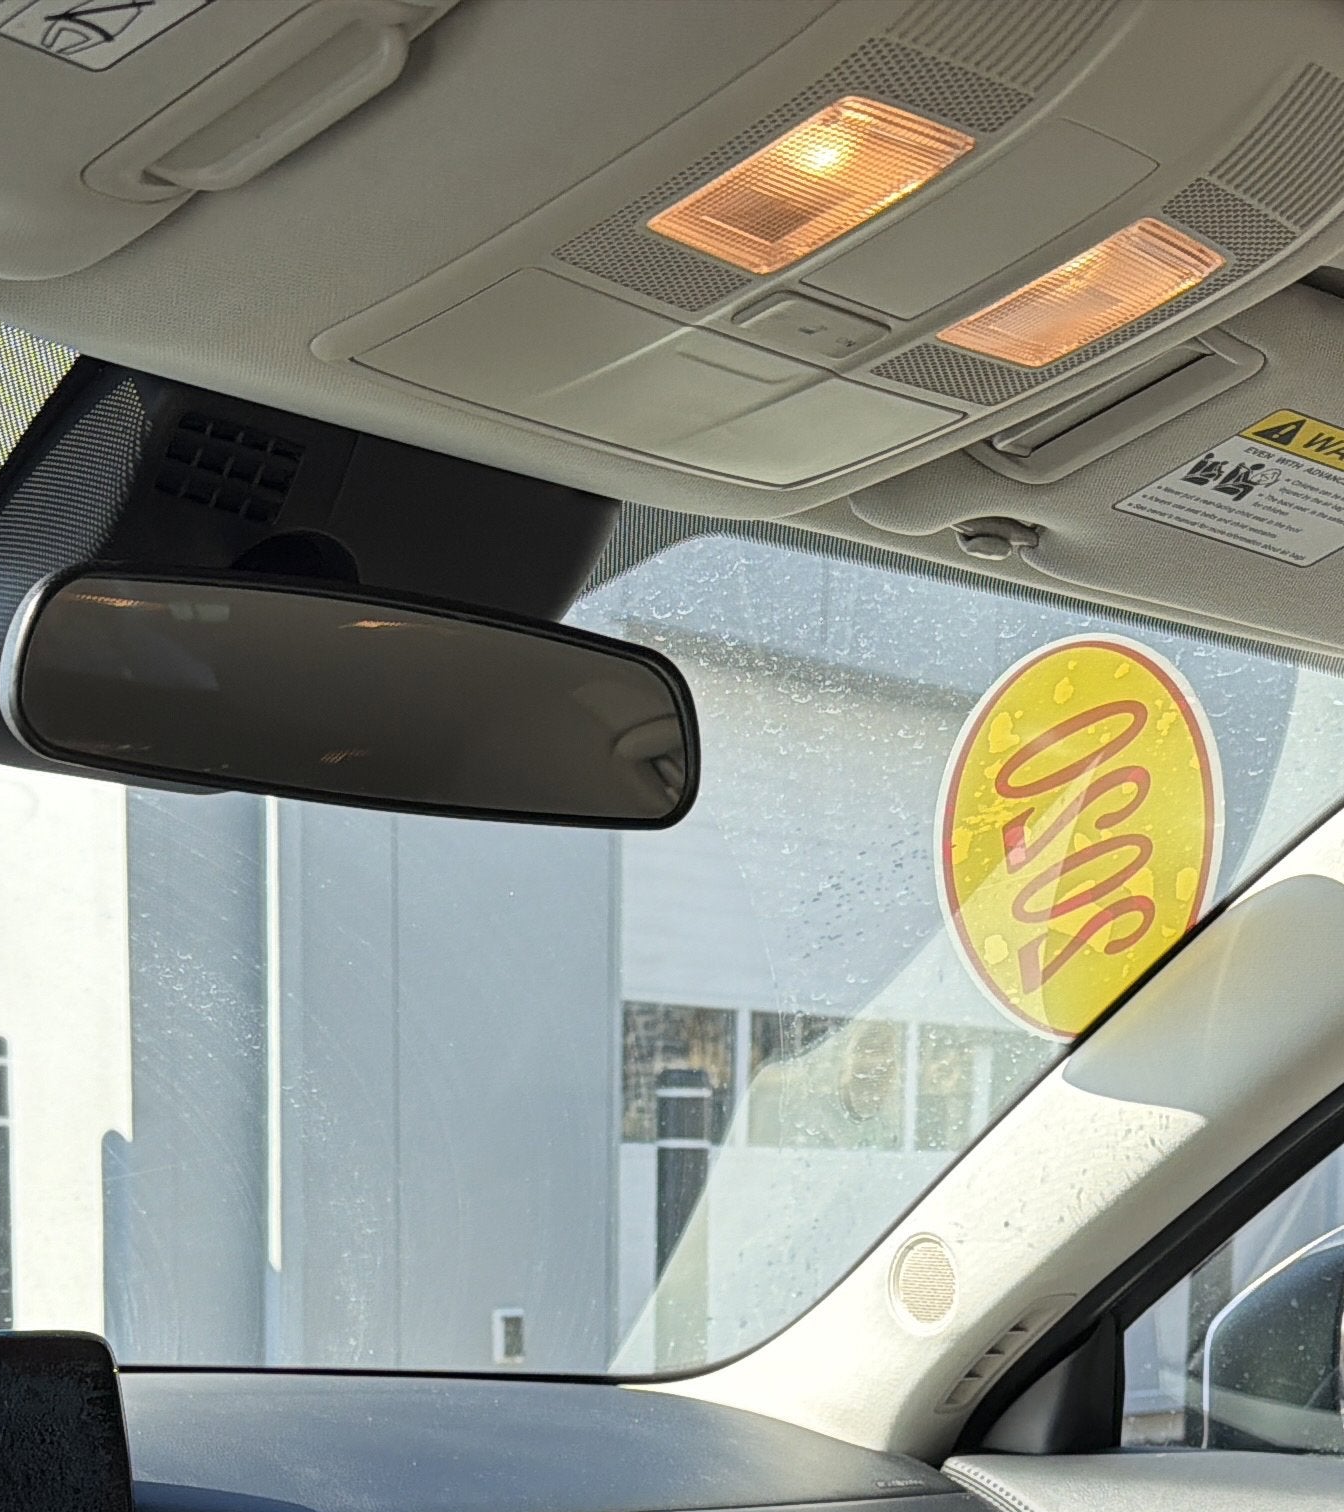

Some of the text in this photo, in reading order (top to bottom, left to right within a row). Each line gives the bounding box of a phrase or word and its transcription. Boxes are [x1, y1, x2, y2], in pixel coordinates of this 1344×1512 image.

[1243, 446, 1276, 460] EVEN
[1275, 457, 1304, 470] WITH
[994, 699, 1156, 995] 2020
